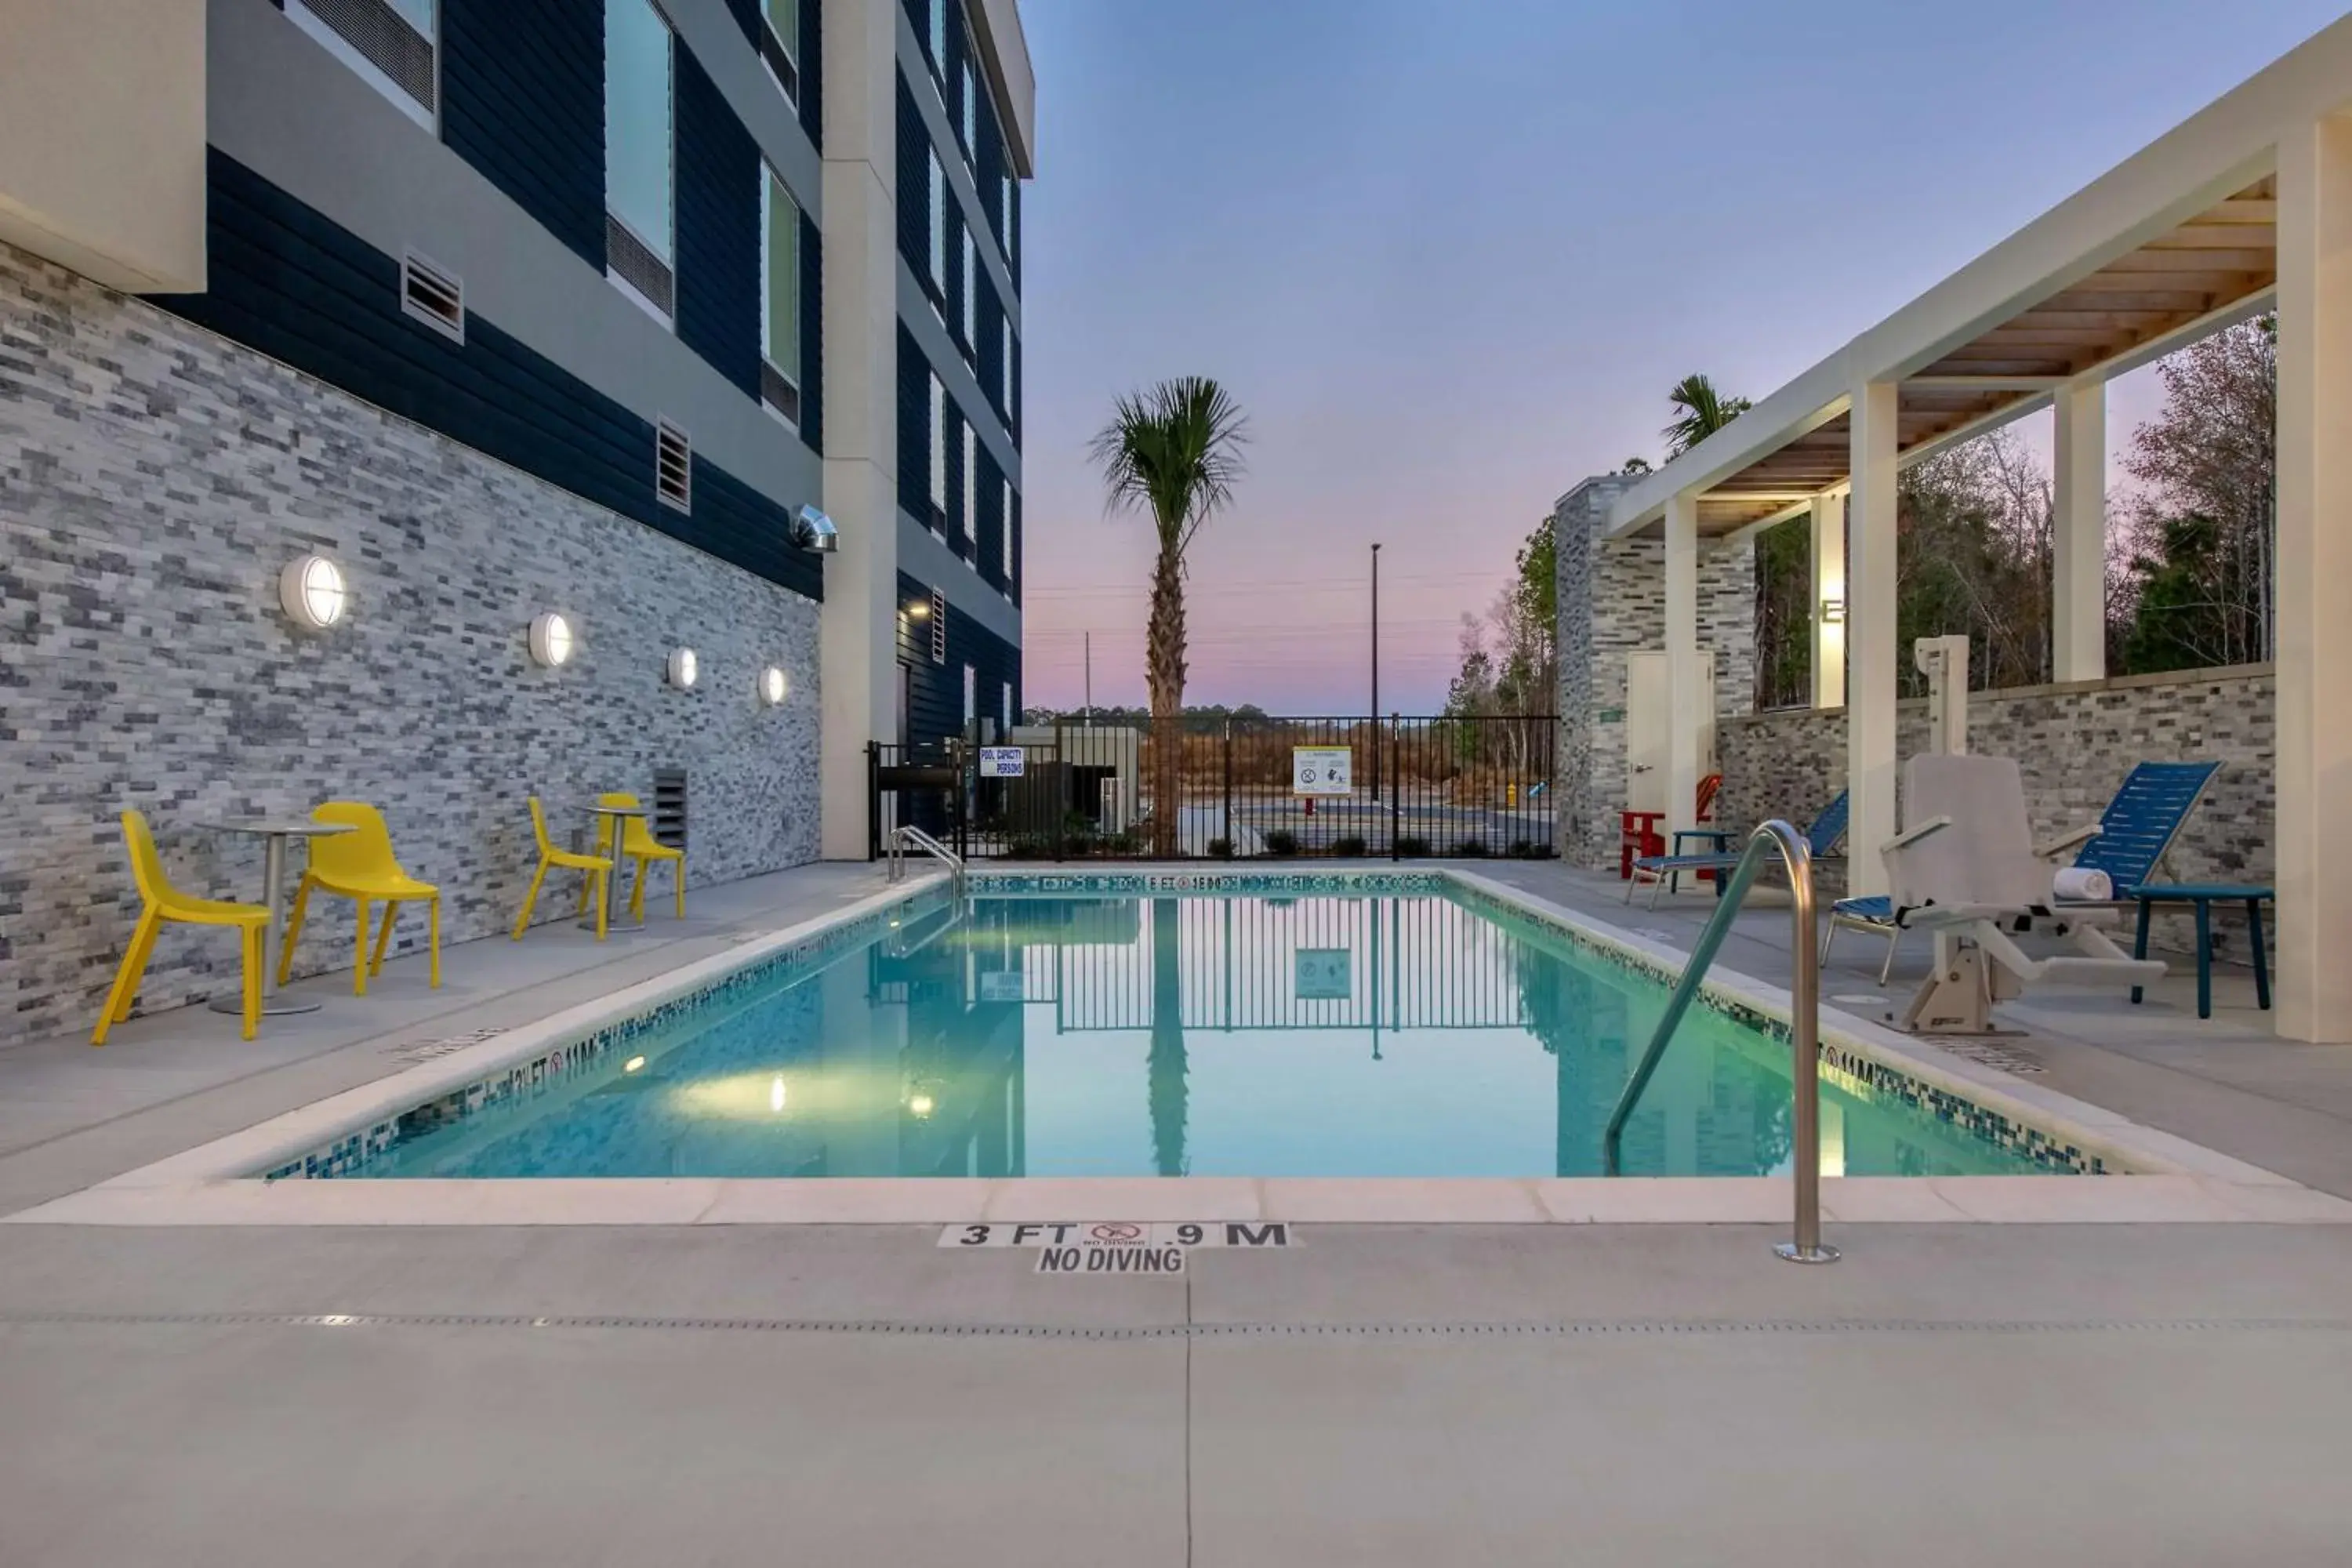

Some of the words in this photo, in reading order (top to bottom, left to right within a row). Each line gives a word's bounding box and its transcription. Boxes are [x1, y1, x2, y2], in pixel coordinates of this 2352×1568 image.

[996, 749, 1022, 759] CAPACITY
[996, 763, 1022, 774] PERSONS
[960, 1225, 991, 1245] 3
[1012, 1224, 1078, 1245] FT
[1226, 1224, 1287, 1246] M
[1040, 1247, 1081, 1272] NO
[1087, 1247, 1181, 1272] DIVING
